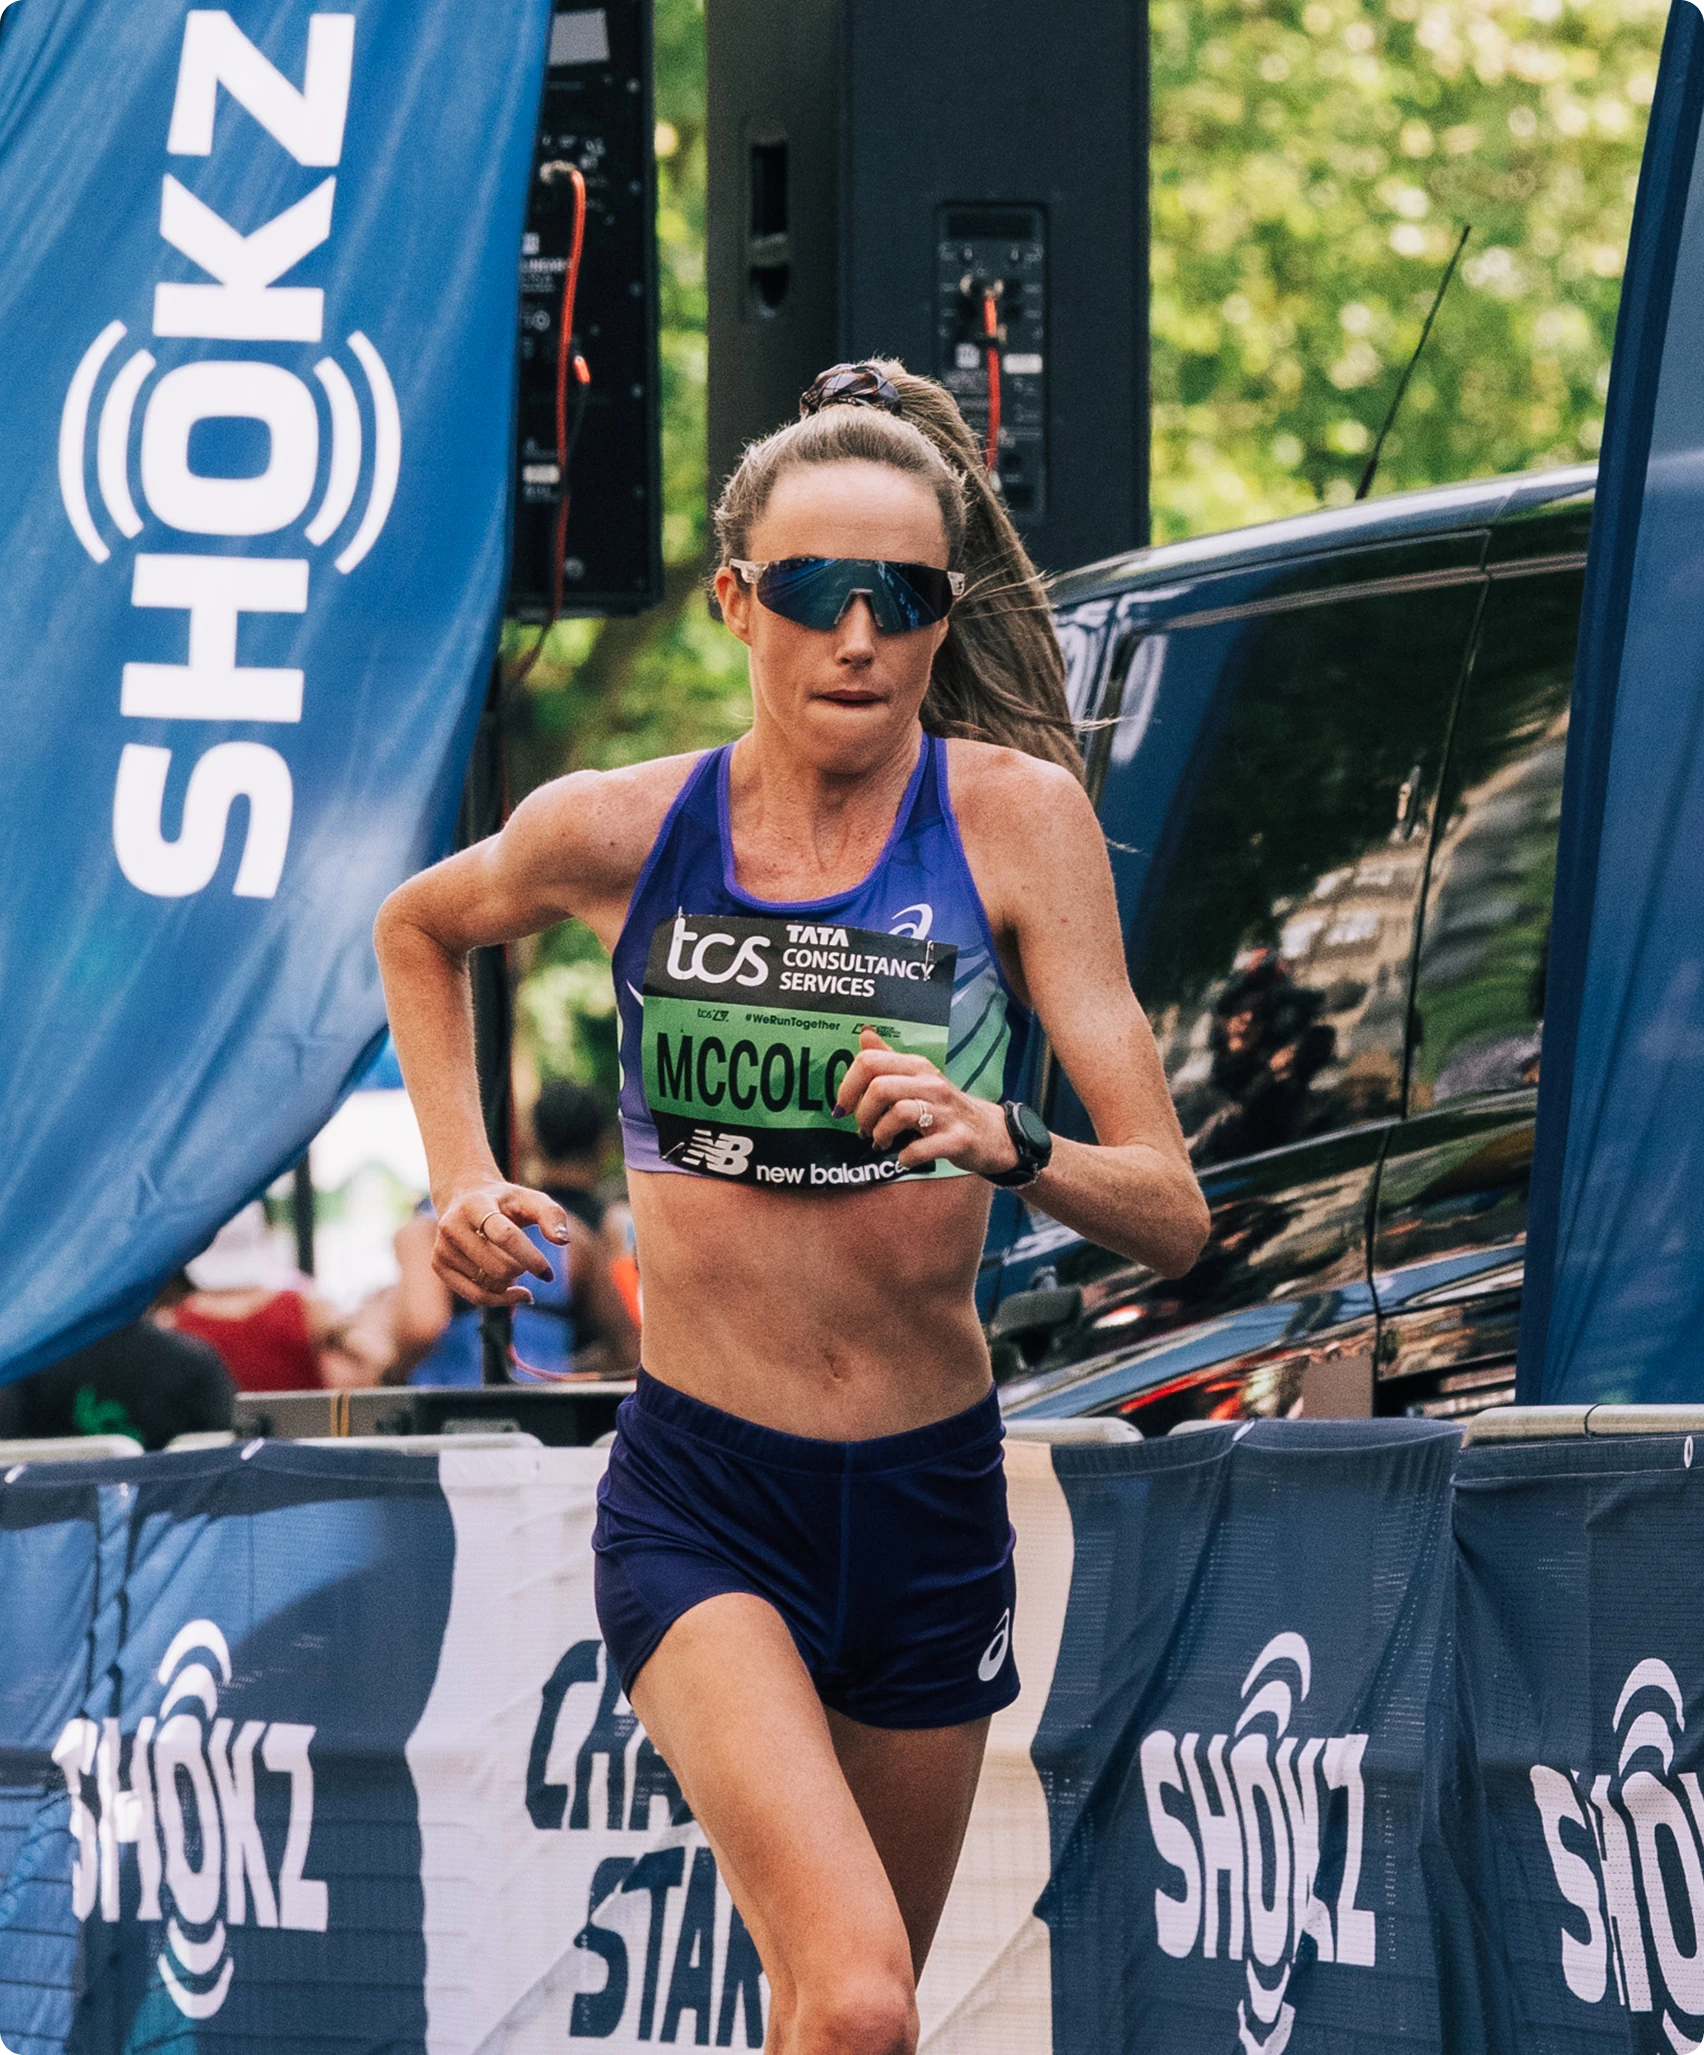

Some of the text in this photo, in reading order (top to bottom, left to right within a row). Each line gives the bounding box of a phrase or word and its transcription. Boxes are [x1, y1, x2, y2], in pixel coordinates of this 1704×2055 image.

[113, 10, 355, 899] SHOKZ
[667, 917, 771, 987] tcs
[786, 924, 849, 947] TATA
[779, 972, 876, 997] SERVICES
[782, 948, 935, 981] CONSULTANCY
[745, 1013, 841, 1030] #WeRunTogether
[756, 1164, 805, 1184] new
[52, 1714, 329, 1932] SHOKZ
[1140, 1729, 1376, 1967] SHOKZ
[1529, 1764, 1704, 2016] SHO
